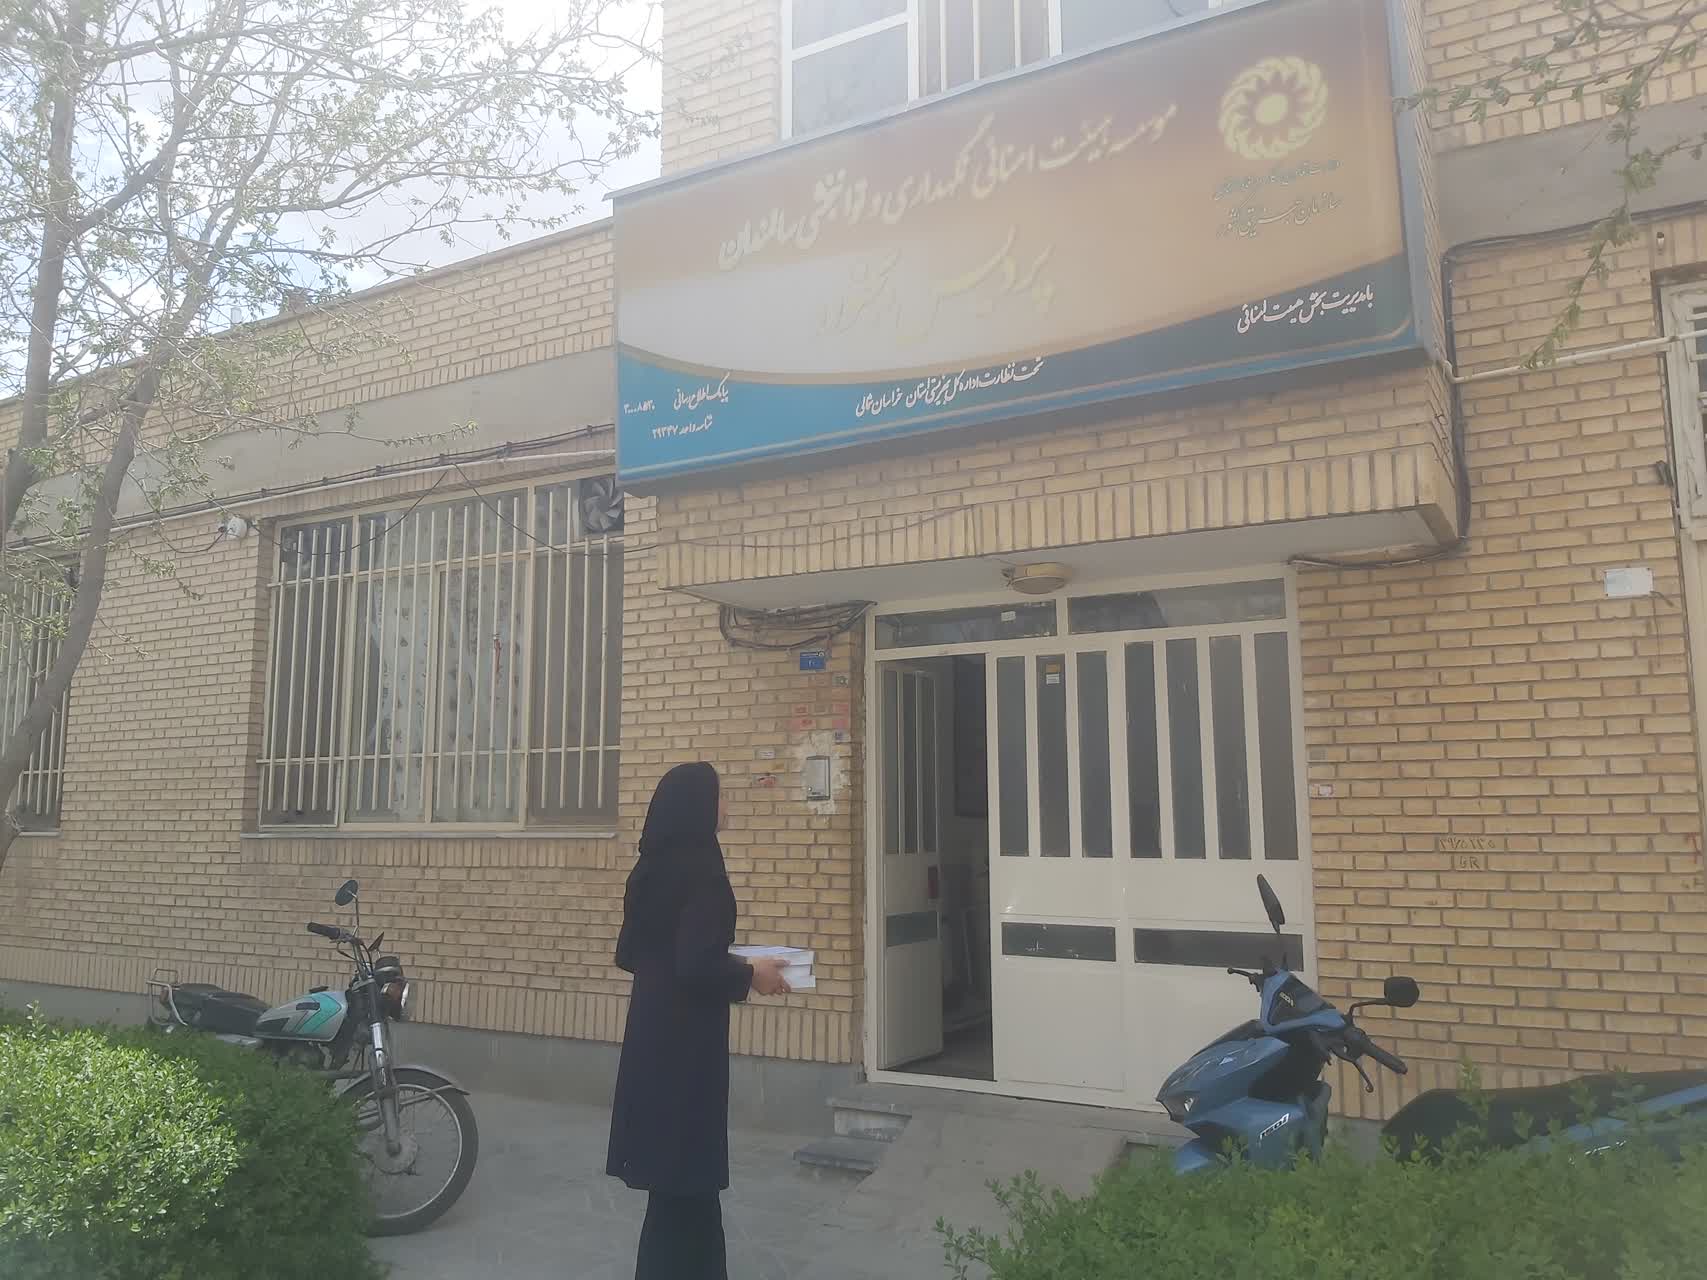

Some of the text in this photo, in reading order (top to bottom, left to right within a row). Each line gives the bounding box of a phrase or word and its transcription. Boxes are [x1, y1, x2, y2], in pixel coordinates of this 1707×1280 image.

[1321, 289, 1367, 315] مدیریت
[978, 361, 1017, 389] نظارت
[1012, 355, 1045, 383] تحت
[958, 374, 980, 394] اداره
[855, 391, 873, 418] شمالی
[871, 387, 904, 416] خراسان
